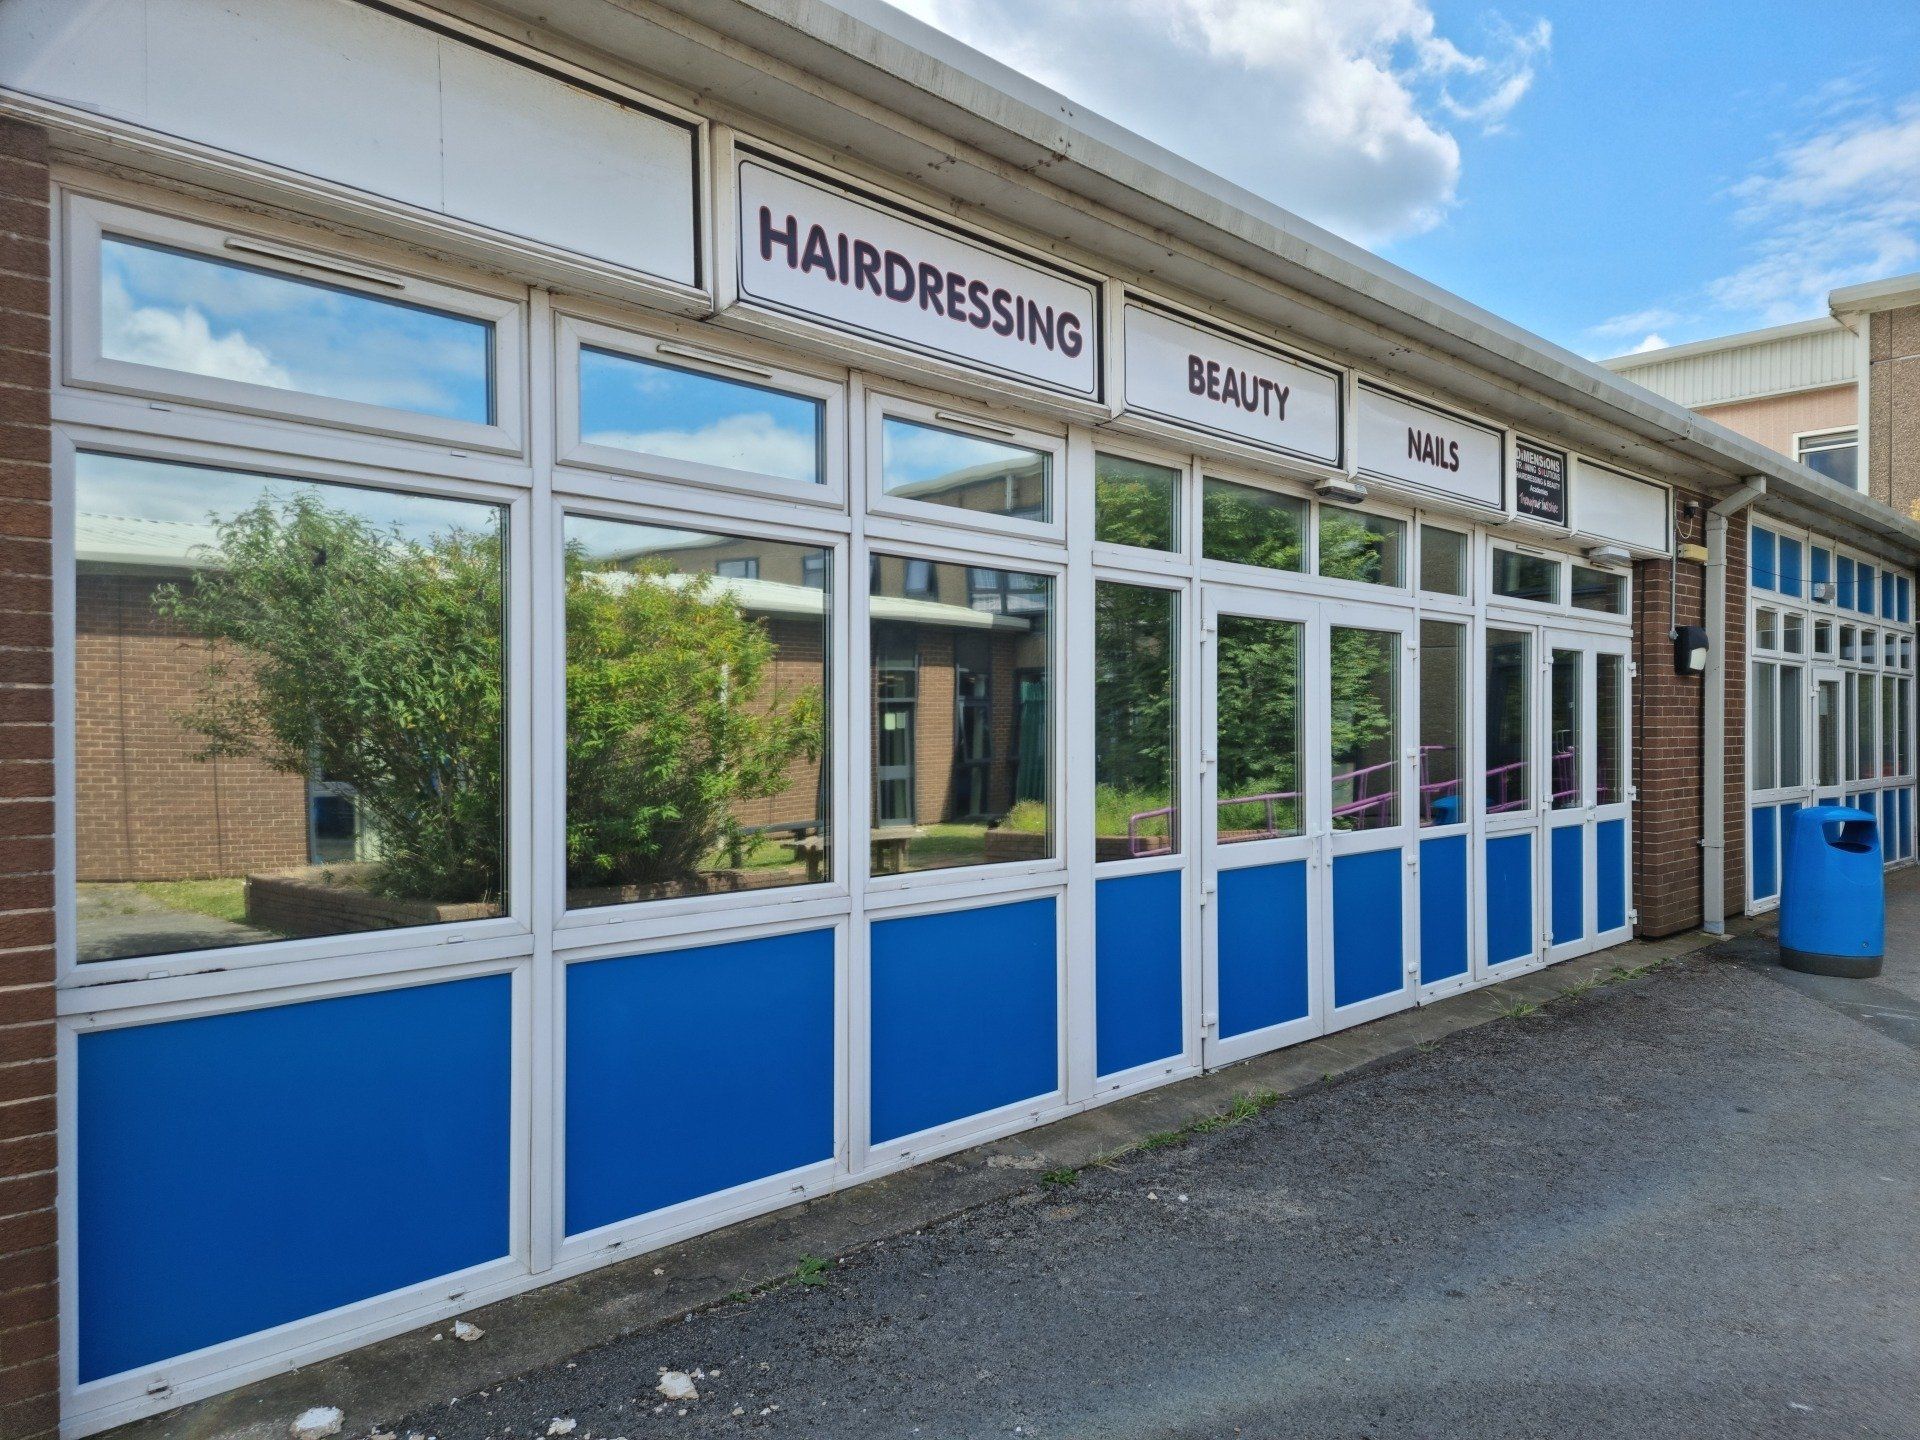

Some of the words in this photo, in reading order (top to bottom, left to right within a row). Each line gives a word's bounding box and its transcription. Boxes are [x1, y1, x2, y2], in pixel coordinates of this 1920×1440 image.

[759, 205, 1083, 358] HAIRDRESSING
[1188, 354, 1290, 421] BEAUTY
[1408, 426, 1460, 473] NAILS
